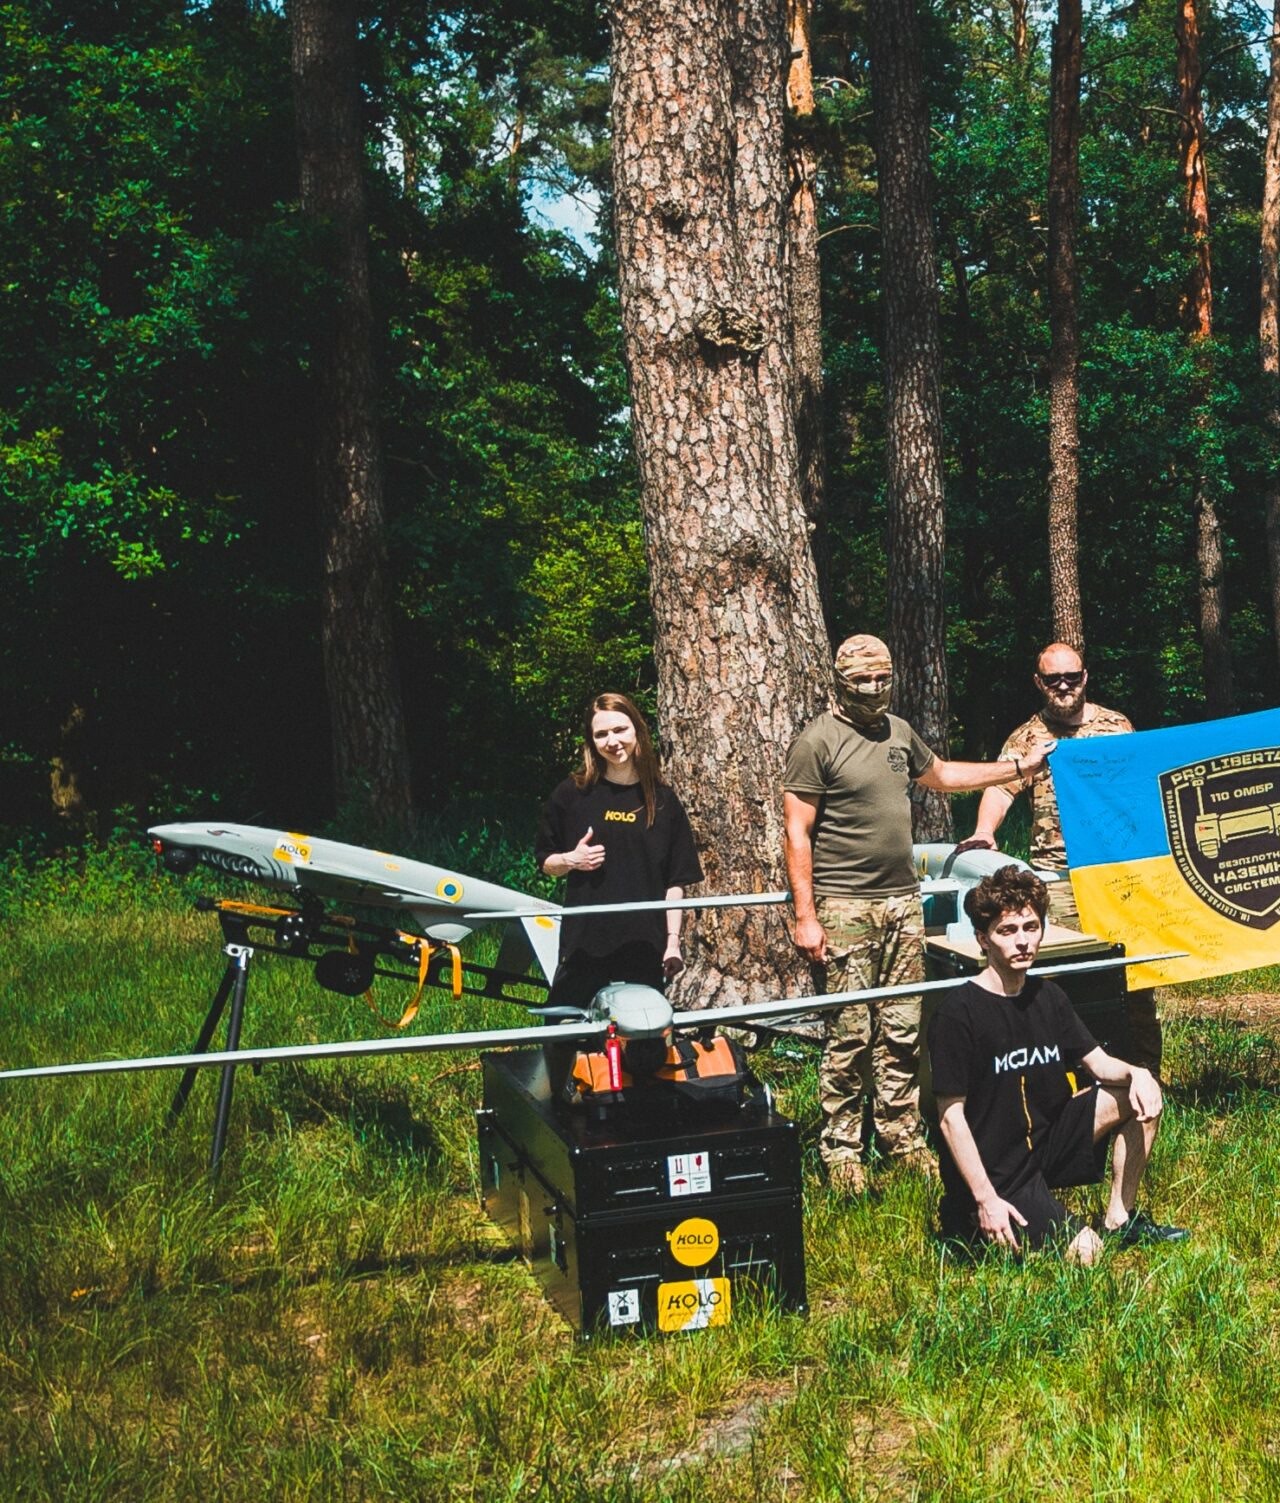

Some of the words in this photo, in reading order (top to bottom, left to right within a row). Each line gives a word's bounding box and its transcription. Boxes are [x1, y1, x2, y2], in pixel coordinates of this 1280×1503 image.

[1170, 765, 1207, 785] PRO
[1209, 792, 1230, 803] 110
[1233, 782, 1274, 799] ОМБР
